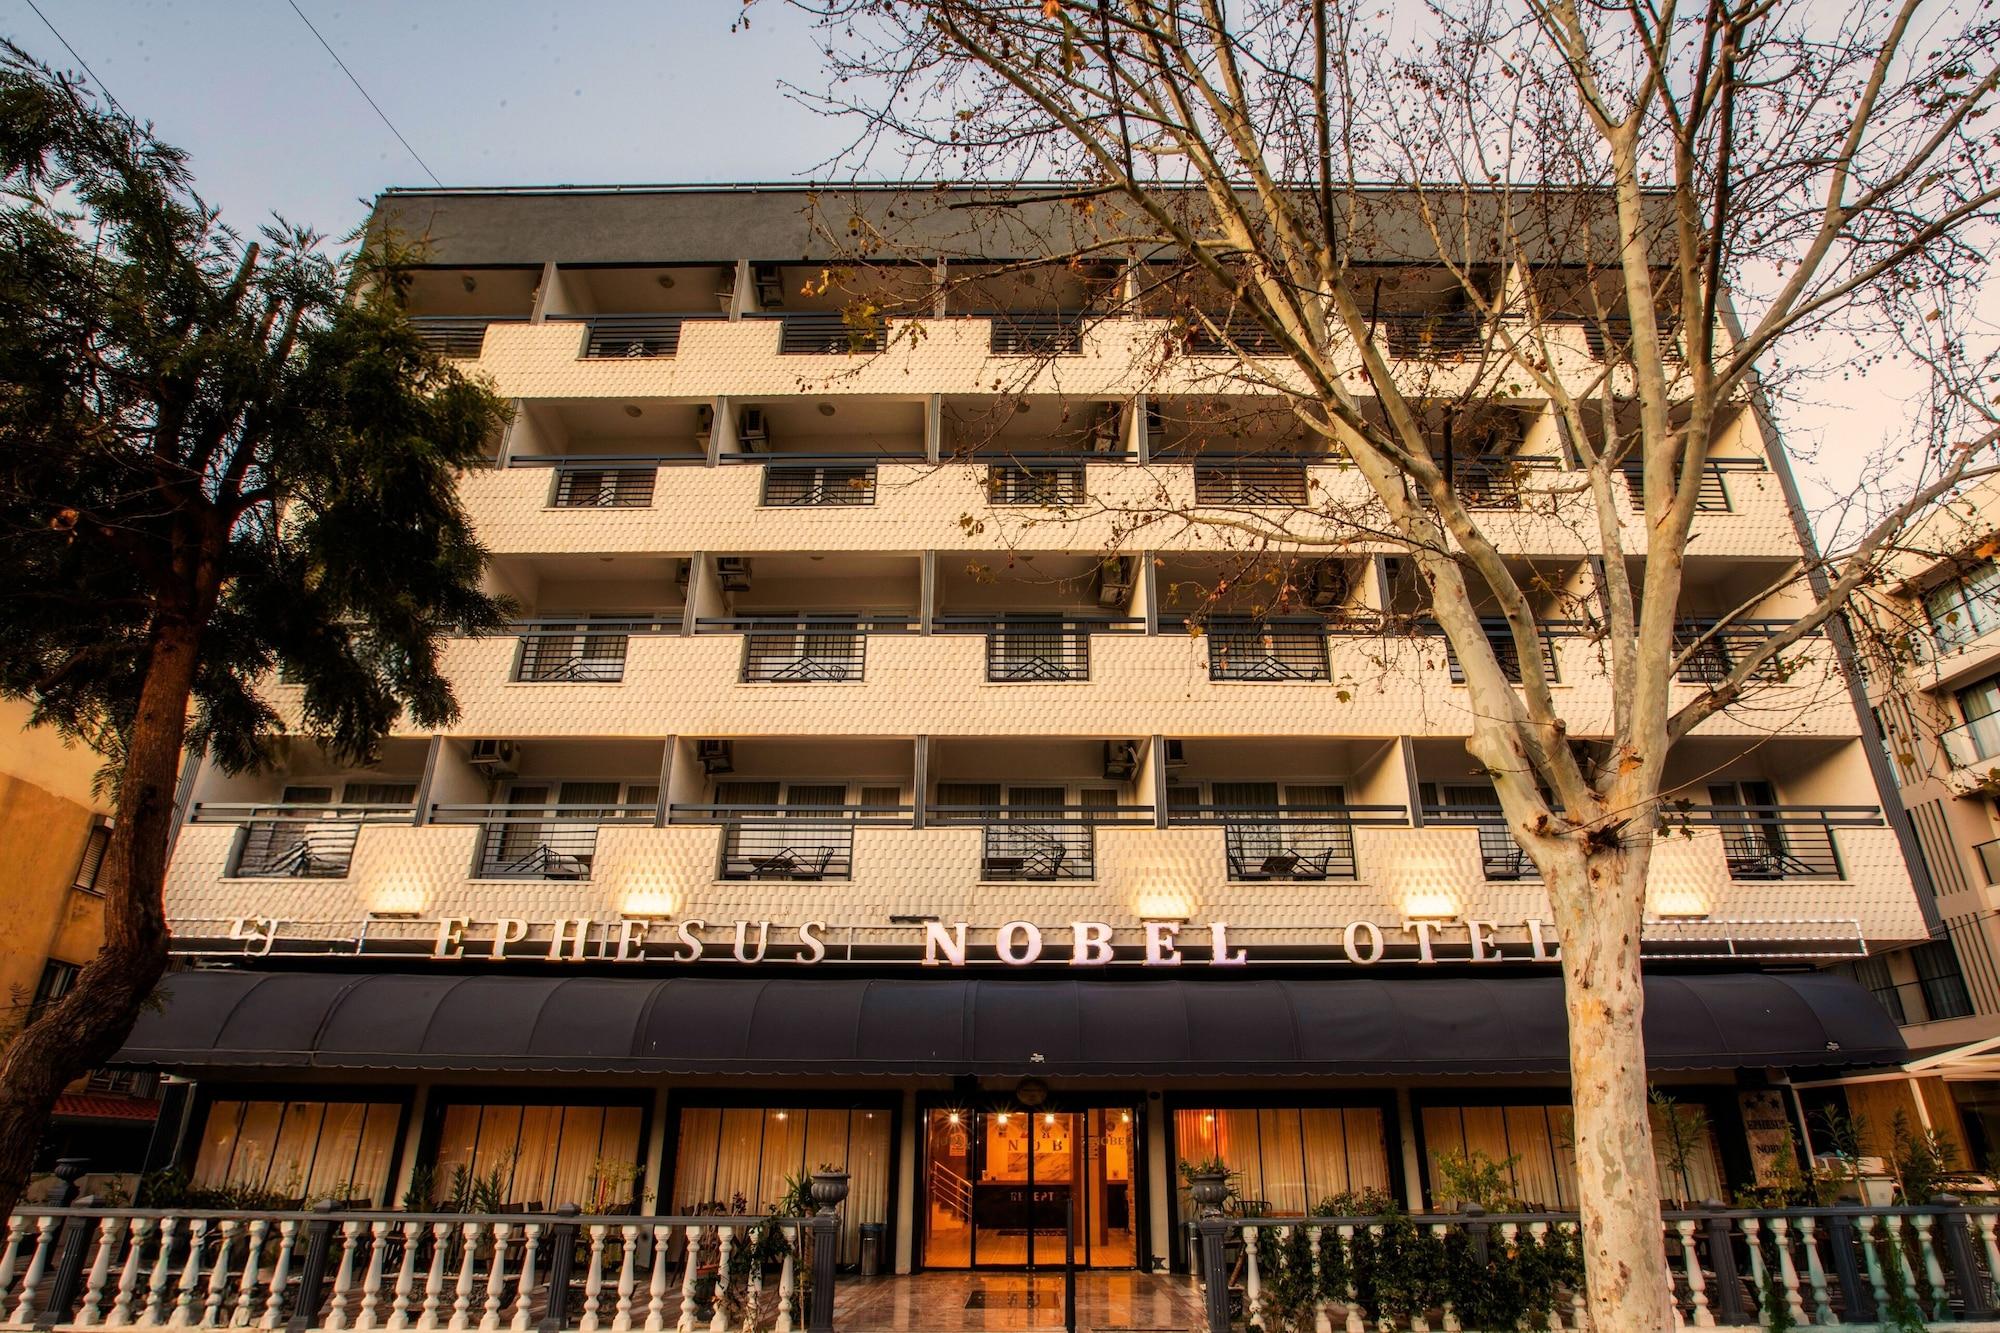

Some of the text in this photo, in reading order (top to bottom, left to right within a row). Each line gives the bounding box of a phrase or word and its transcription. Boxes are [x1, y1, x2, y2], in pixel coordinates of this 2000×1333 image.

[430, 917, 1562, 966] EPHESUS NOBEL OTEL
